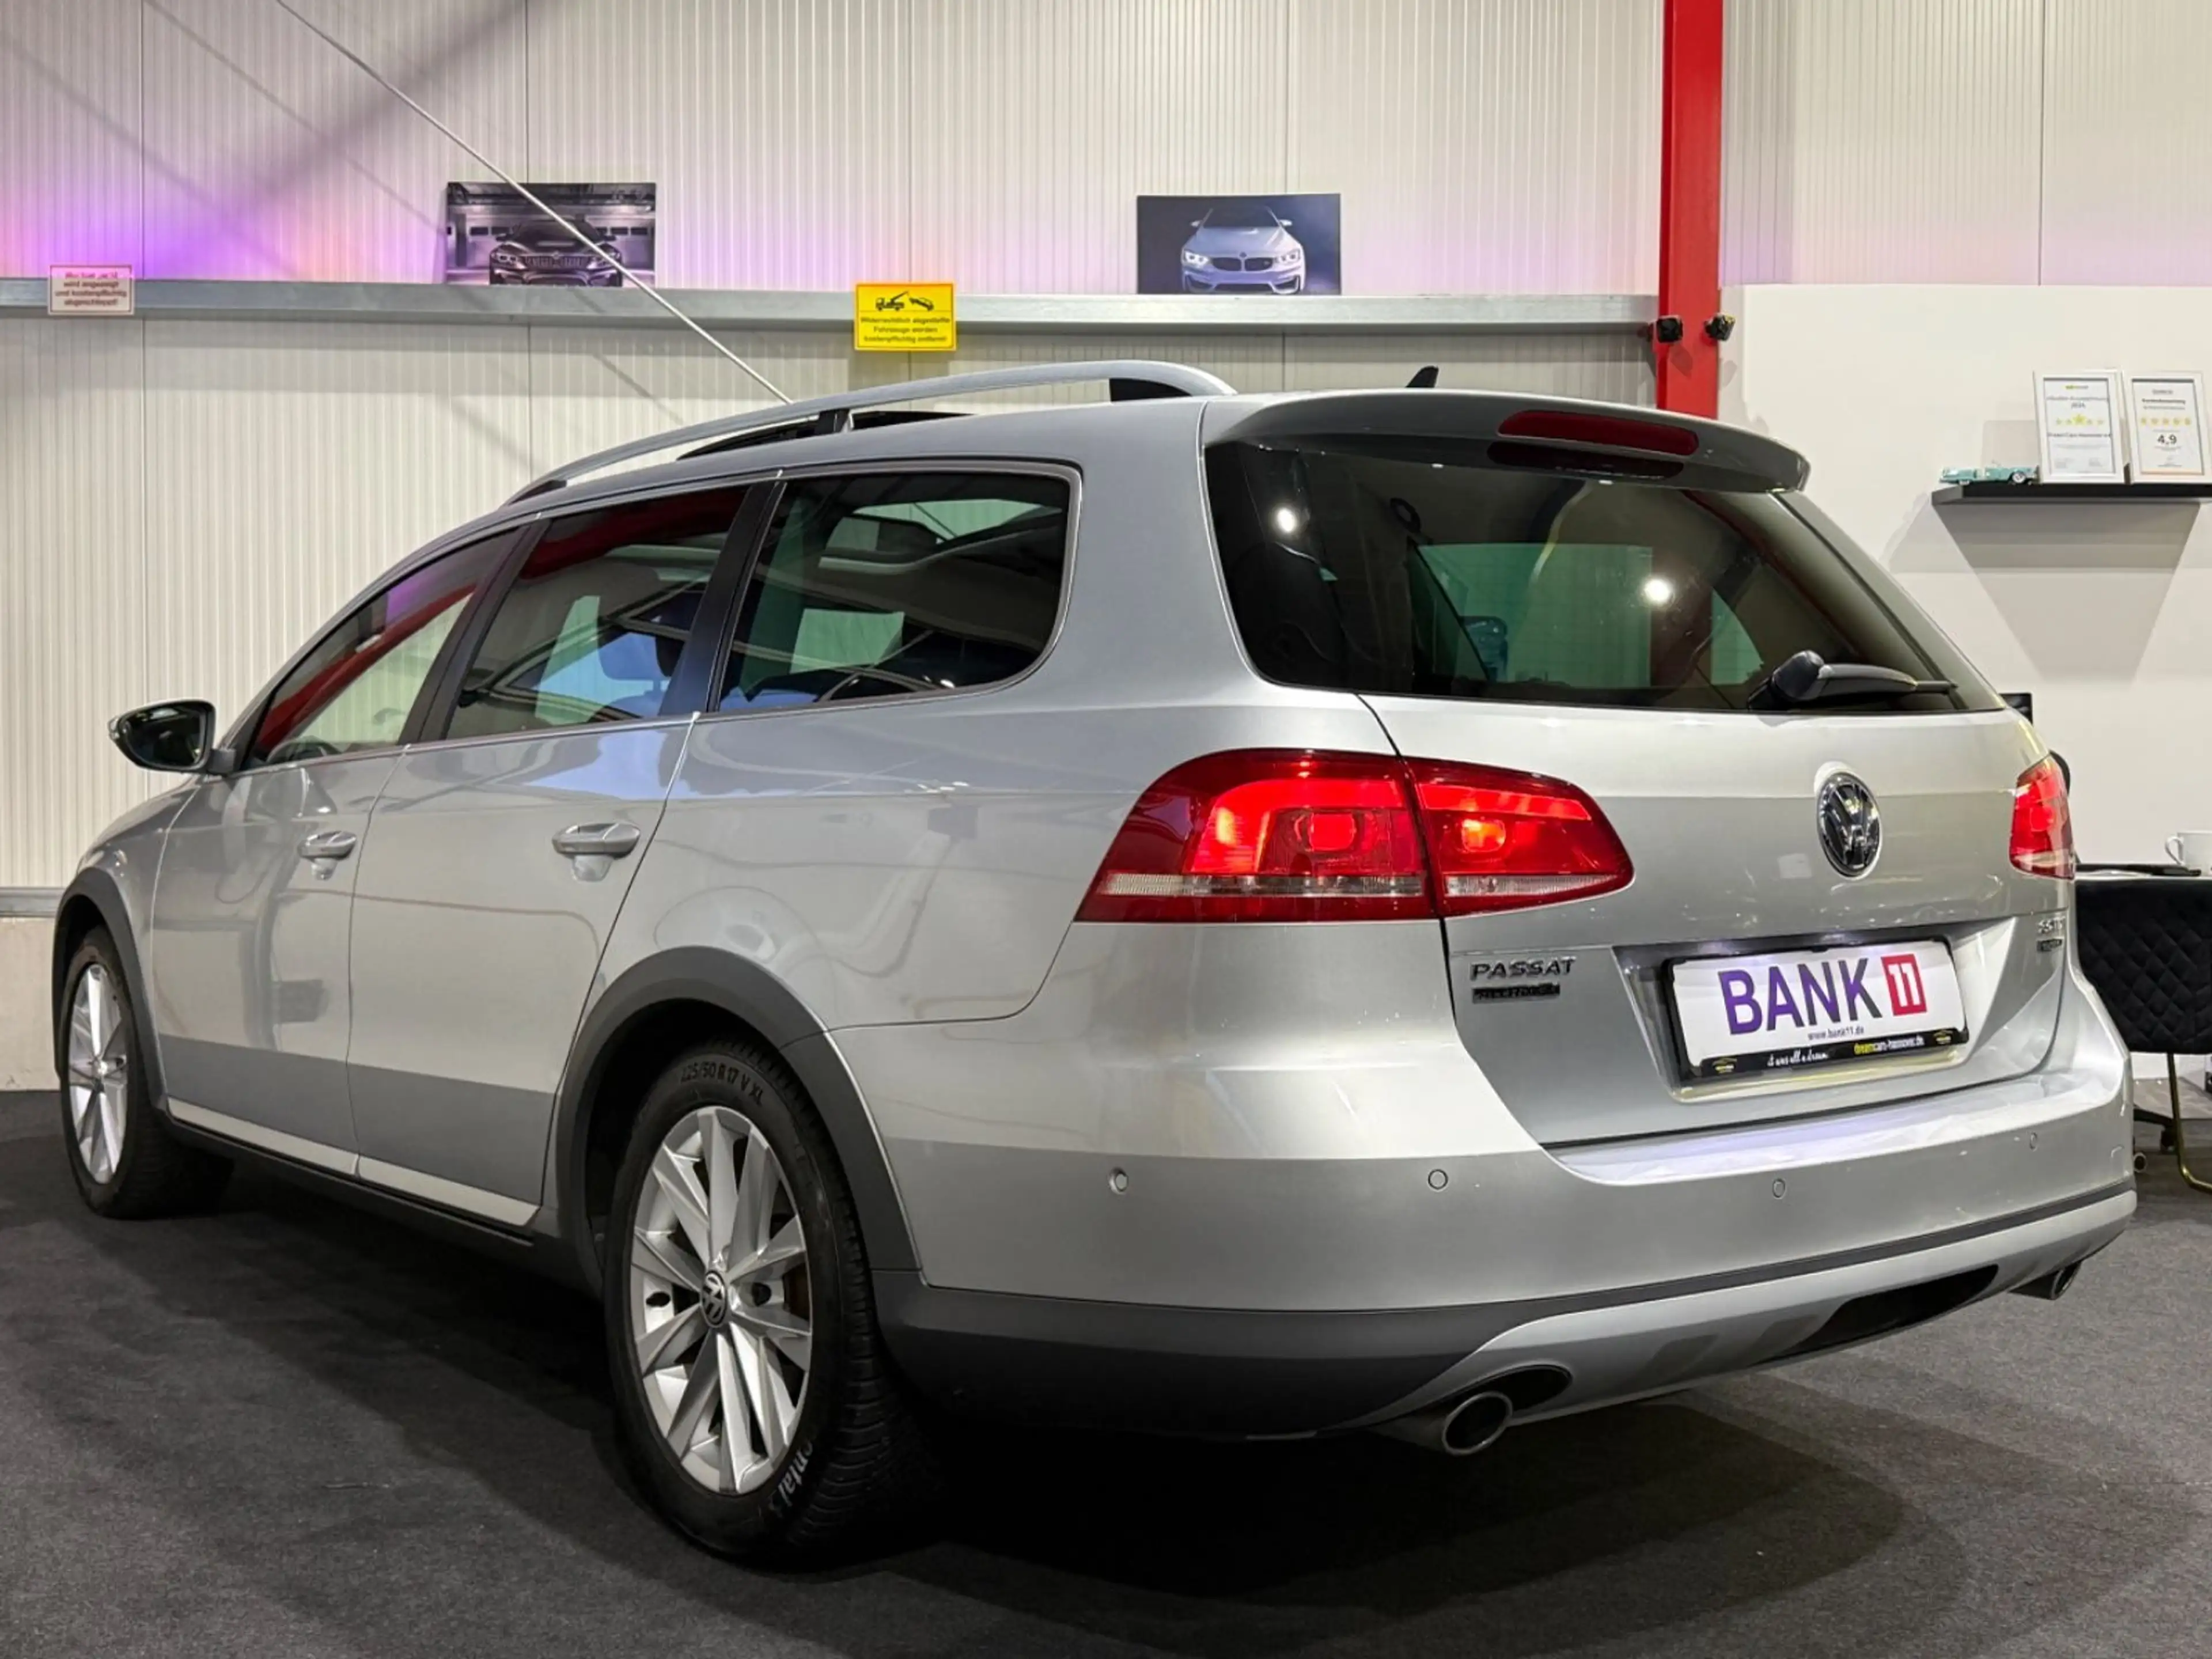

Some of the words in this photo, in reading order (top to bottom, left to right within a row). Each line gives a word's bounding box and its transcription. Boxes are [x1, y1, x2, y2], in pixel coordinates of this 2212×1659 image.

[1469, 955, 1577, 981] PASSAT
[1718, 957, 1883, 1035] BANK
[1888, 960, 1923, 1008] 11
[1808, 1025, 1864, 1040] www.bank11.de
[727, 1066, 740, 1085] 17
